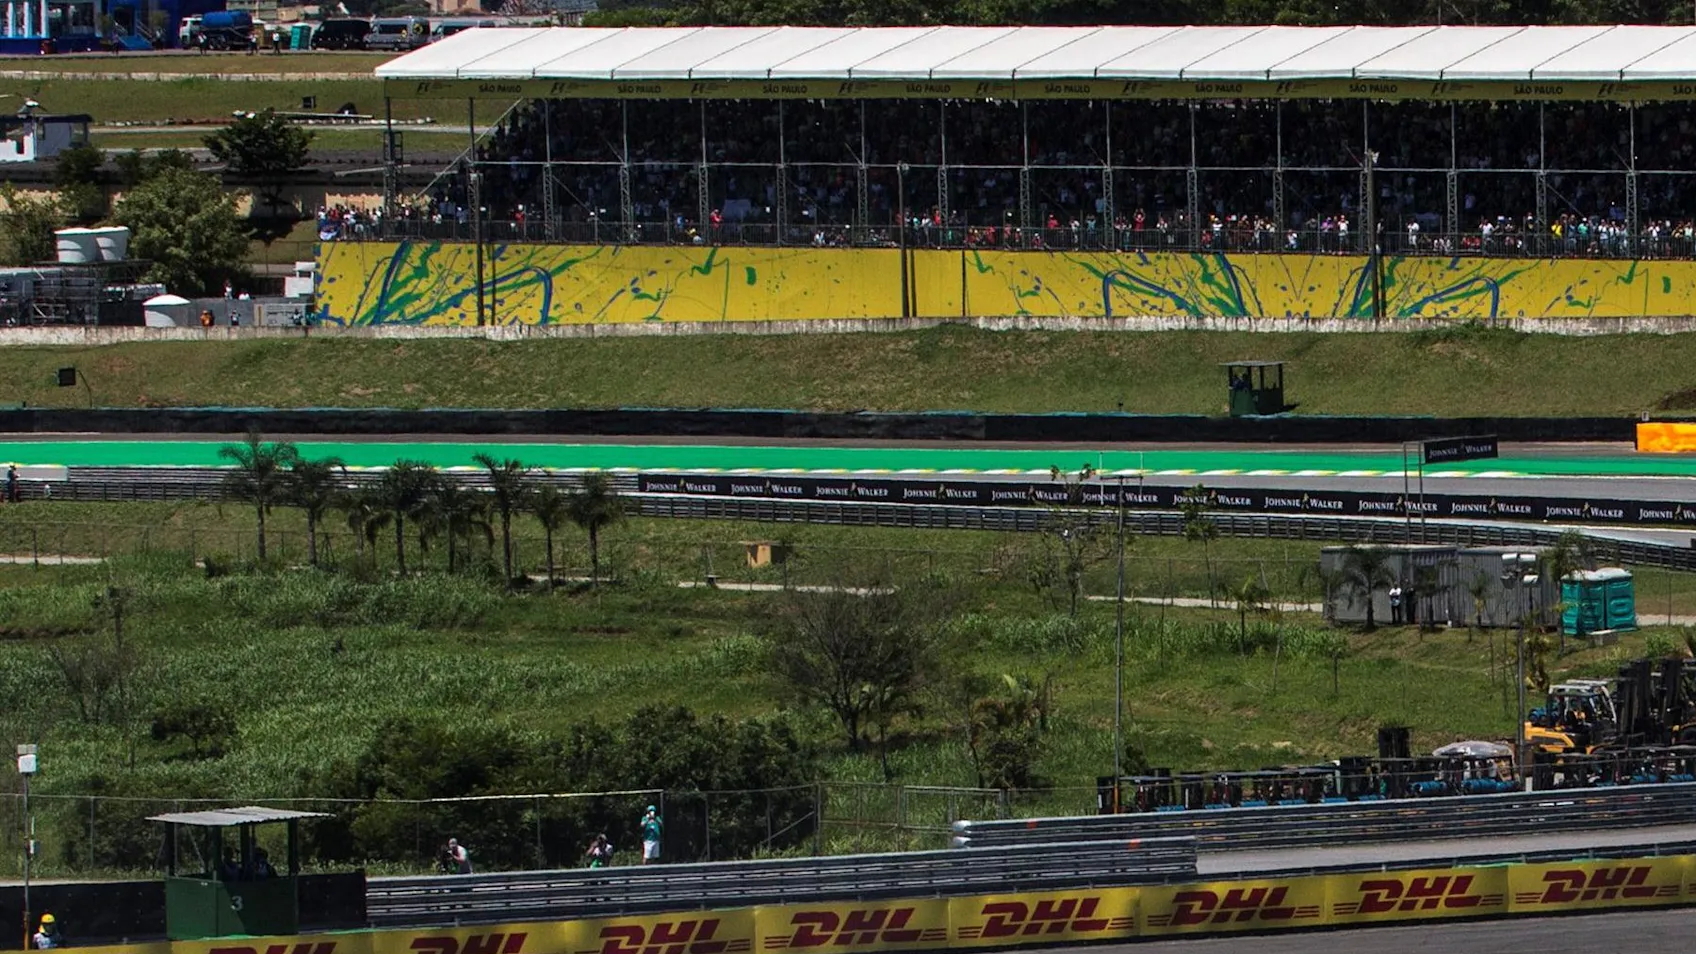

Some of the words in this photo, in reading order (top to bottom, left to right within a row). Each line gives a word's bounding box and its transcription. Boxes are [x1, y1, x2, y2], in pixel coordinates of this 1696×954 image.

[497, 84, 522, 93] PAULO
[636, 85, 661, 93] PAULO
[782, 85, 807, 94] PAULO
[925, 85, 951, 93] PAULO
[1063, 85, 1090, 93] PAULO
[1215, 85, 1242, 93] PAULO
[1370, 85, 1397, 93] PAULO
[1535, 86, 1563, 94] PAULO
[646, 481, 677, 492] JOHNNIE
[686, 483, 716, 493] WALKER
[731, 483, 763, 493] JOHNNIE
[771, 484, 802, 494] WALKER
[816, 485, 848, 496] JOHNNIE
[857, 487, 888, 496] WALKER
[903, 488, 936, 498] JOHNNIE
[946, 489, 977, 498] WALKER
[992, 490, 1026, 500] JOHNNIE
[1035, 491, 1068, 500] WALKER
[1125, 493, 1158, 502] WALKER
[1218, 495, 1251, 505] WALKER
[1264, 497, 1300, 508] JOHNNIE
[1310, 499, 1343, 509] WALKER
[1359, 500, 1394, 510] JOHNNIE
[1404, 501, 1438, 511] WALKER
[1451, 502, 1487, 513] JOHNNIE
[1497, 503, 1531, 513] WALKER
[1546, 506, 1580, 517] JOHNNIE
[1590, 507, 1624, 518] WALKER
[1638, 508, 1672, 519] JOHNNIE
[1542, 866, 1658, 902] DHL
[1358, 875, 1481, 912] DHL
[231, 895, 243, 911] 3
[1171, 886, 1297, 927] DHL
[979, 897, 1109, 938] DHL
[789, 908, 921, 948] DHL
